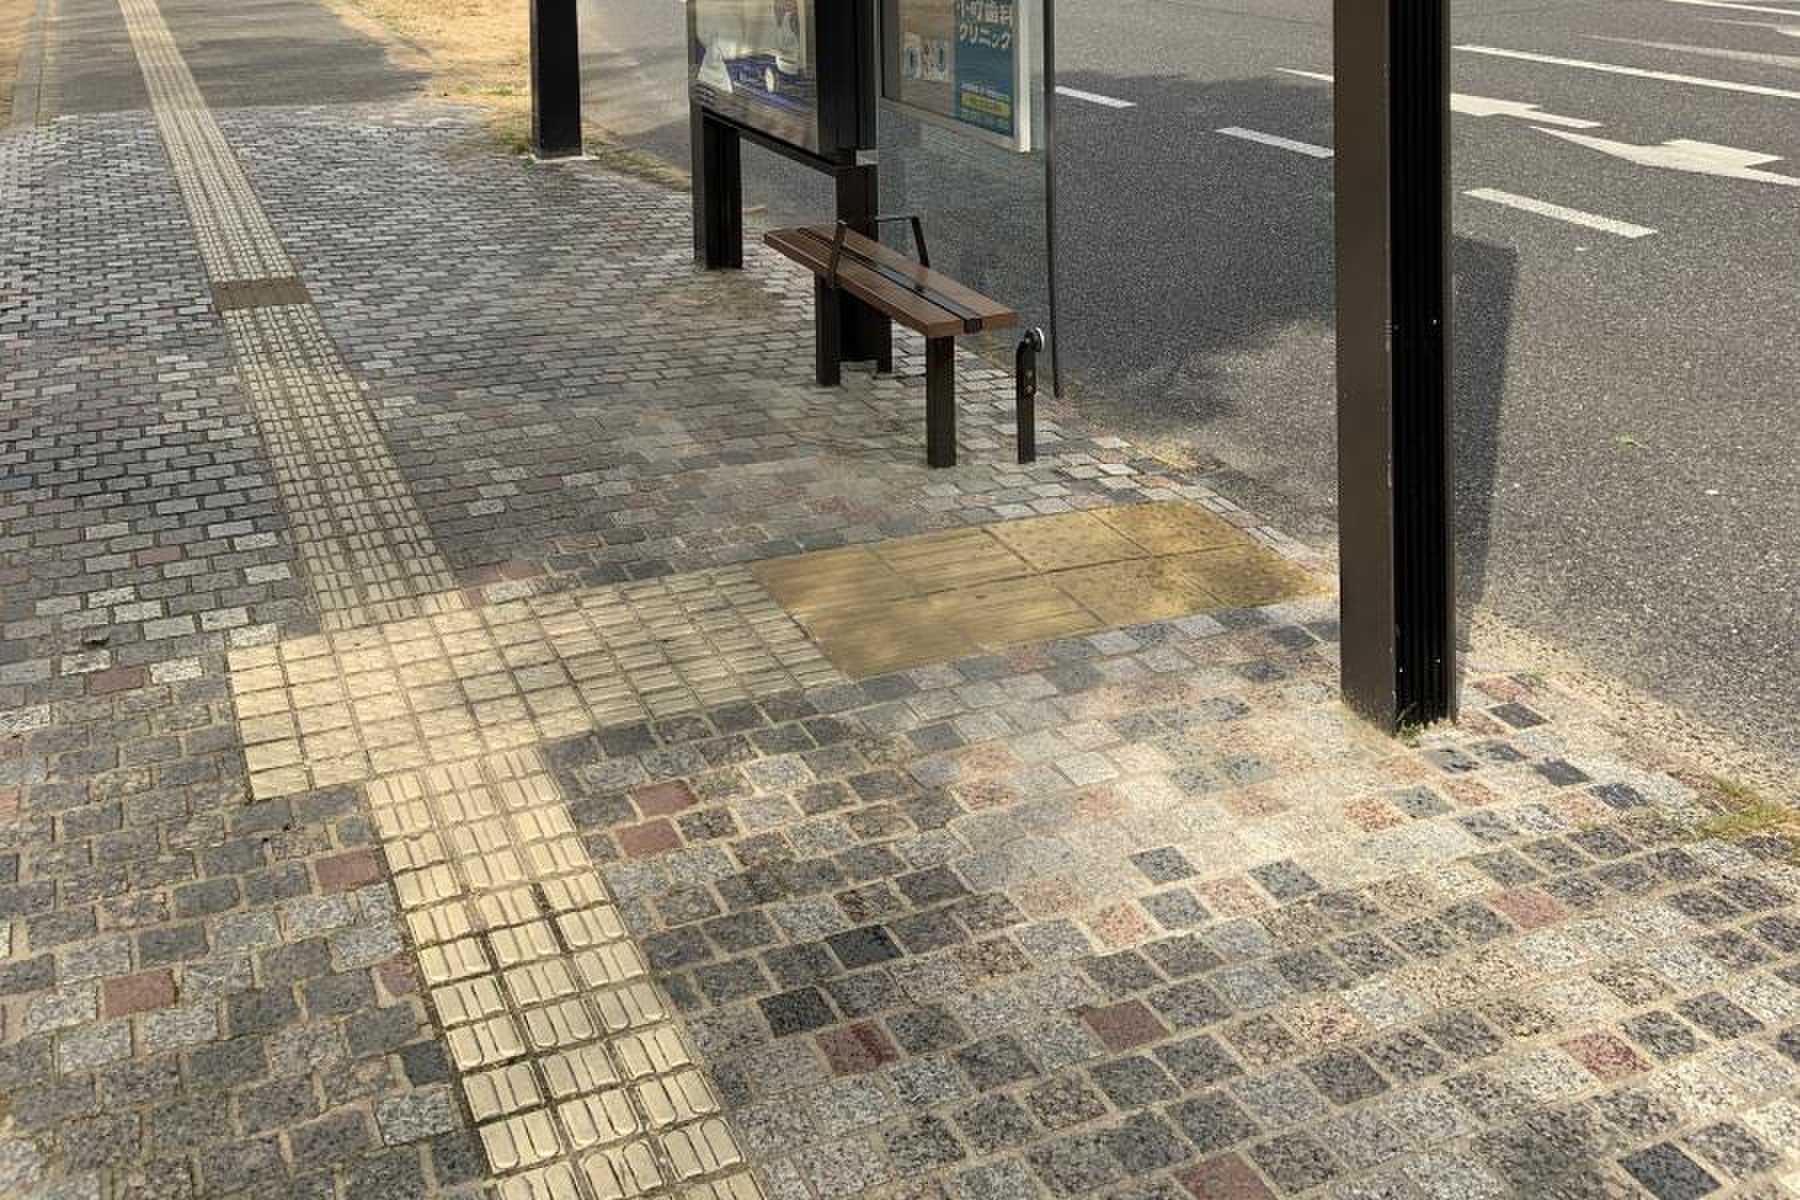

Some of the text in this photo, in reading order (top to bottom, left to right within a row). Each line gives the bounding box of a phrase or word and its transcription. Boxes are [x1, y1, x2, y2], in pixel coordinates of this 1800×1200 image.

[959, 21, 1011, 49] クリニック
